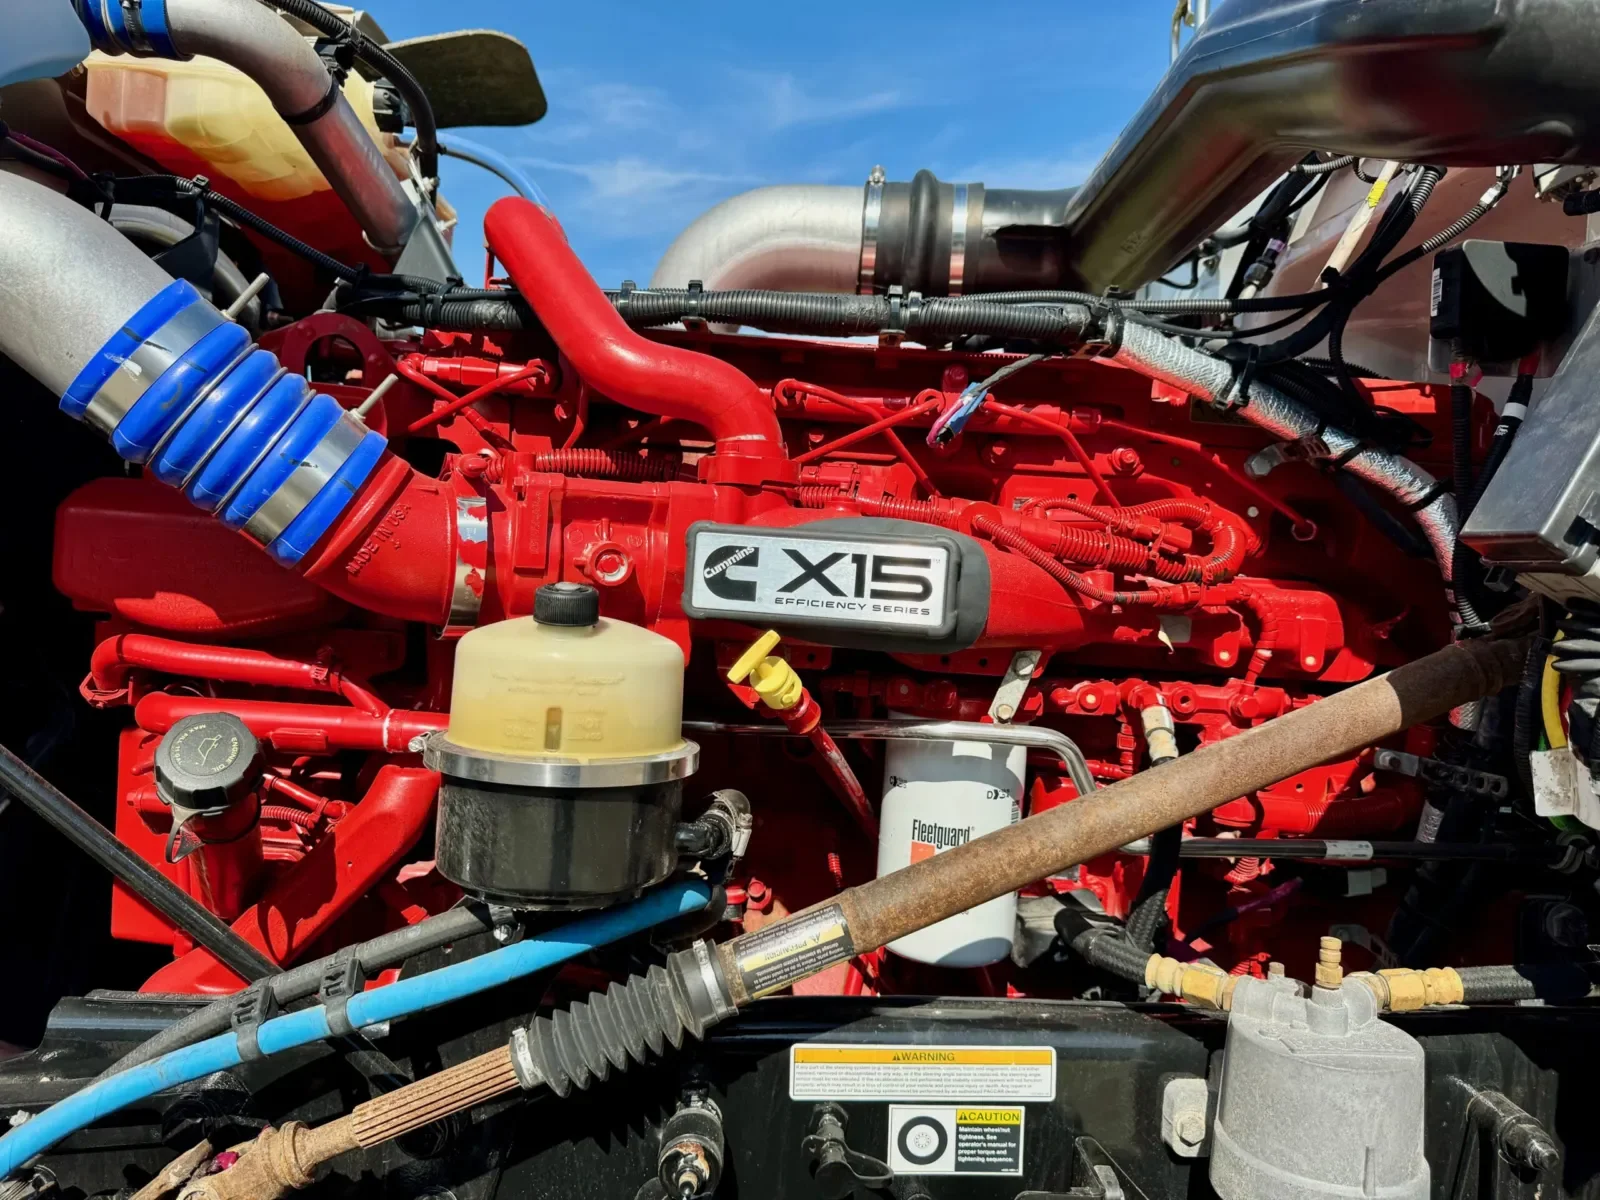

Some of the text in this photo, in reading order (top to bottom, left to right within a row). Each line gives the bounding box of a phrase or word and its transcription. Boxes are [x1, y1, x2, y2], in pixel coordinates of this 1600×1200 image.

[345, 503, 412, 575] MADE IN USA
[704, 546, 755, 578] Cummins
[776, 548, 933, 603] X15
[774, 598, 930, 616] EFFICIENCY SERIES
[179, 732, 189, 744] FILL
[188, 724, 206, 733] MAX
[211, 736, 238, 772] ENGINE OIL
[912, 818, 970, 850] Fleetguard
[900, 1052, 956, 1062] WARNING
[968, 1112, 1019, 1122] CAUTION
